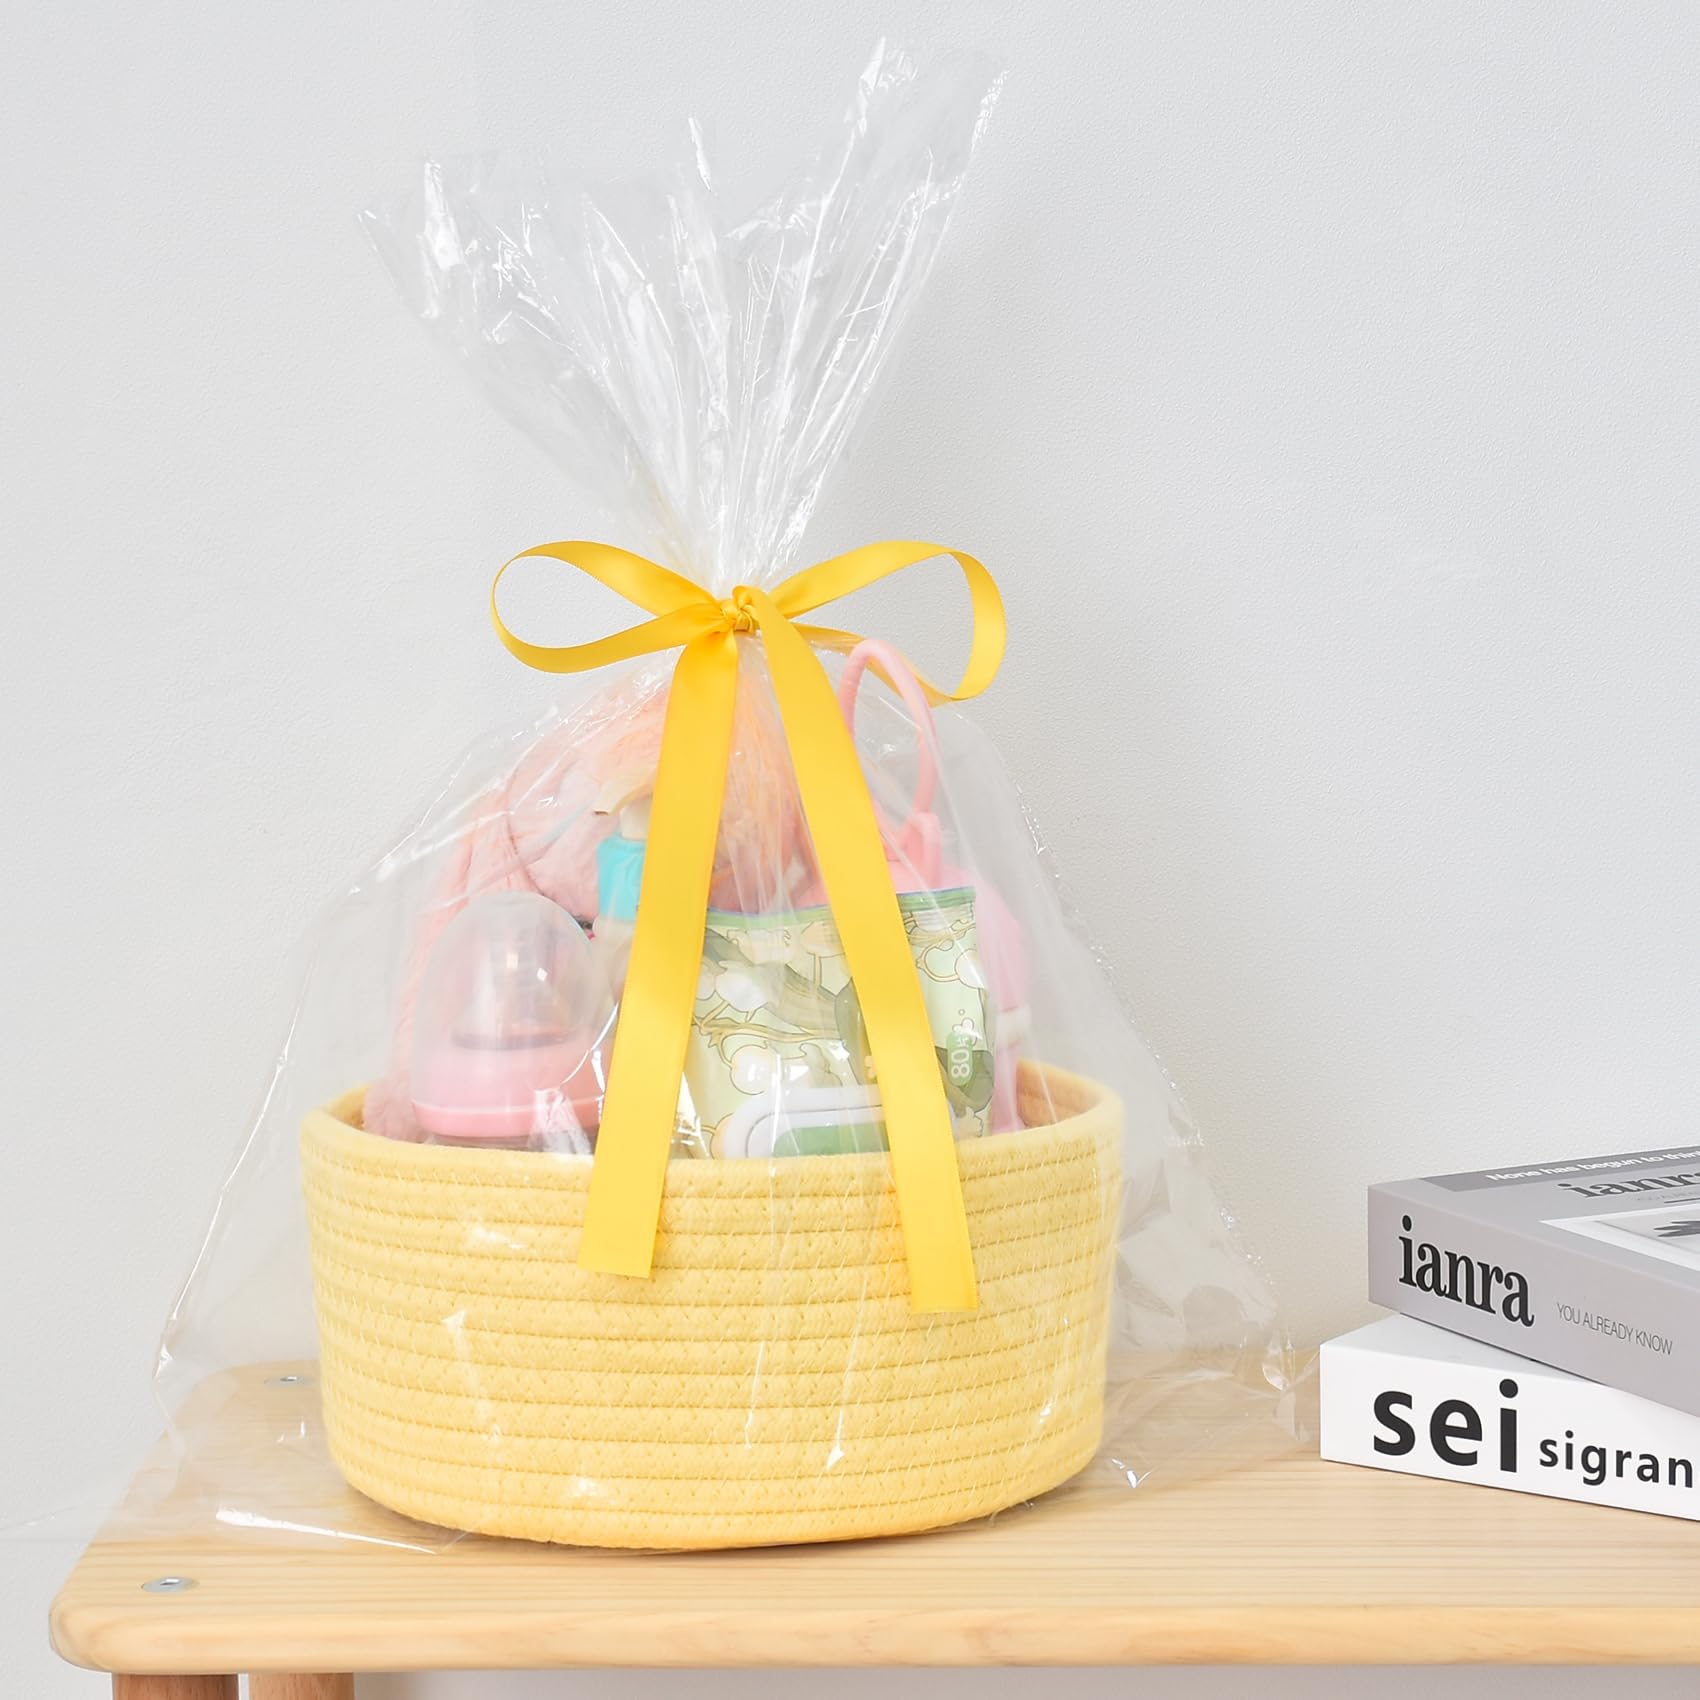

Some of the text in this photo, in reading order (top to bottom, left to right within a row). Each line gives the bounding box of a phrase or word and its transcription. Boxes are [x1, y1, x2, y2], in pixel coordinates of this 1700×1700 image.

[1485, 1170, 1541, 1181] None
[1540, 1163, 1580, 1175] has
[1578, 1158, 1643, 1170] begun
[1398, 1215, 1535, 1328] ianra
[1556, 1301, 1673, 1355] YOU ALREADY KNOW
[1373, 1378, 1694, 1488] sei sigran
